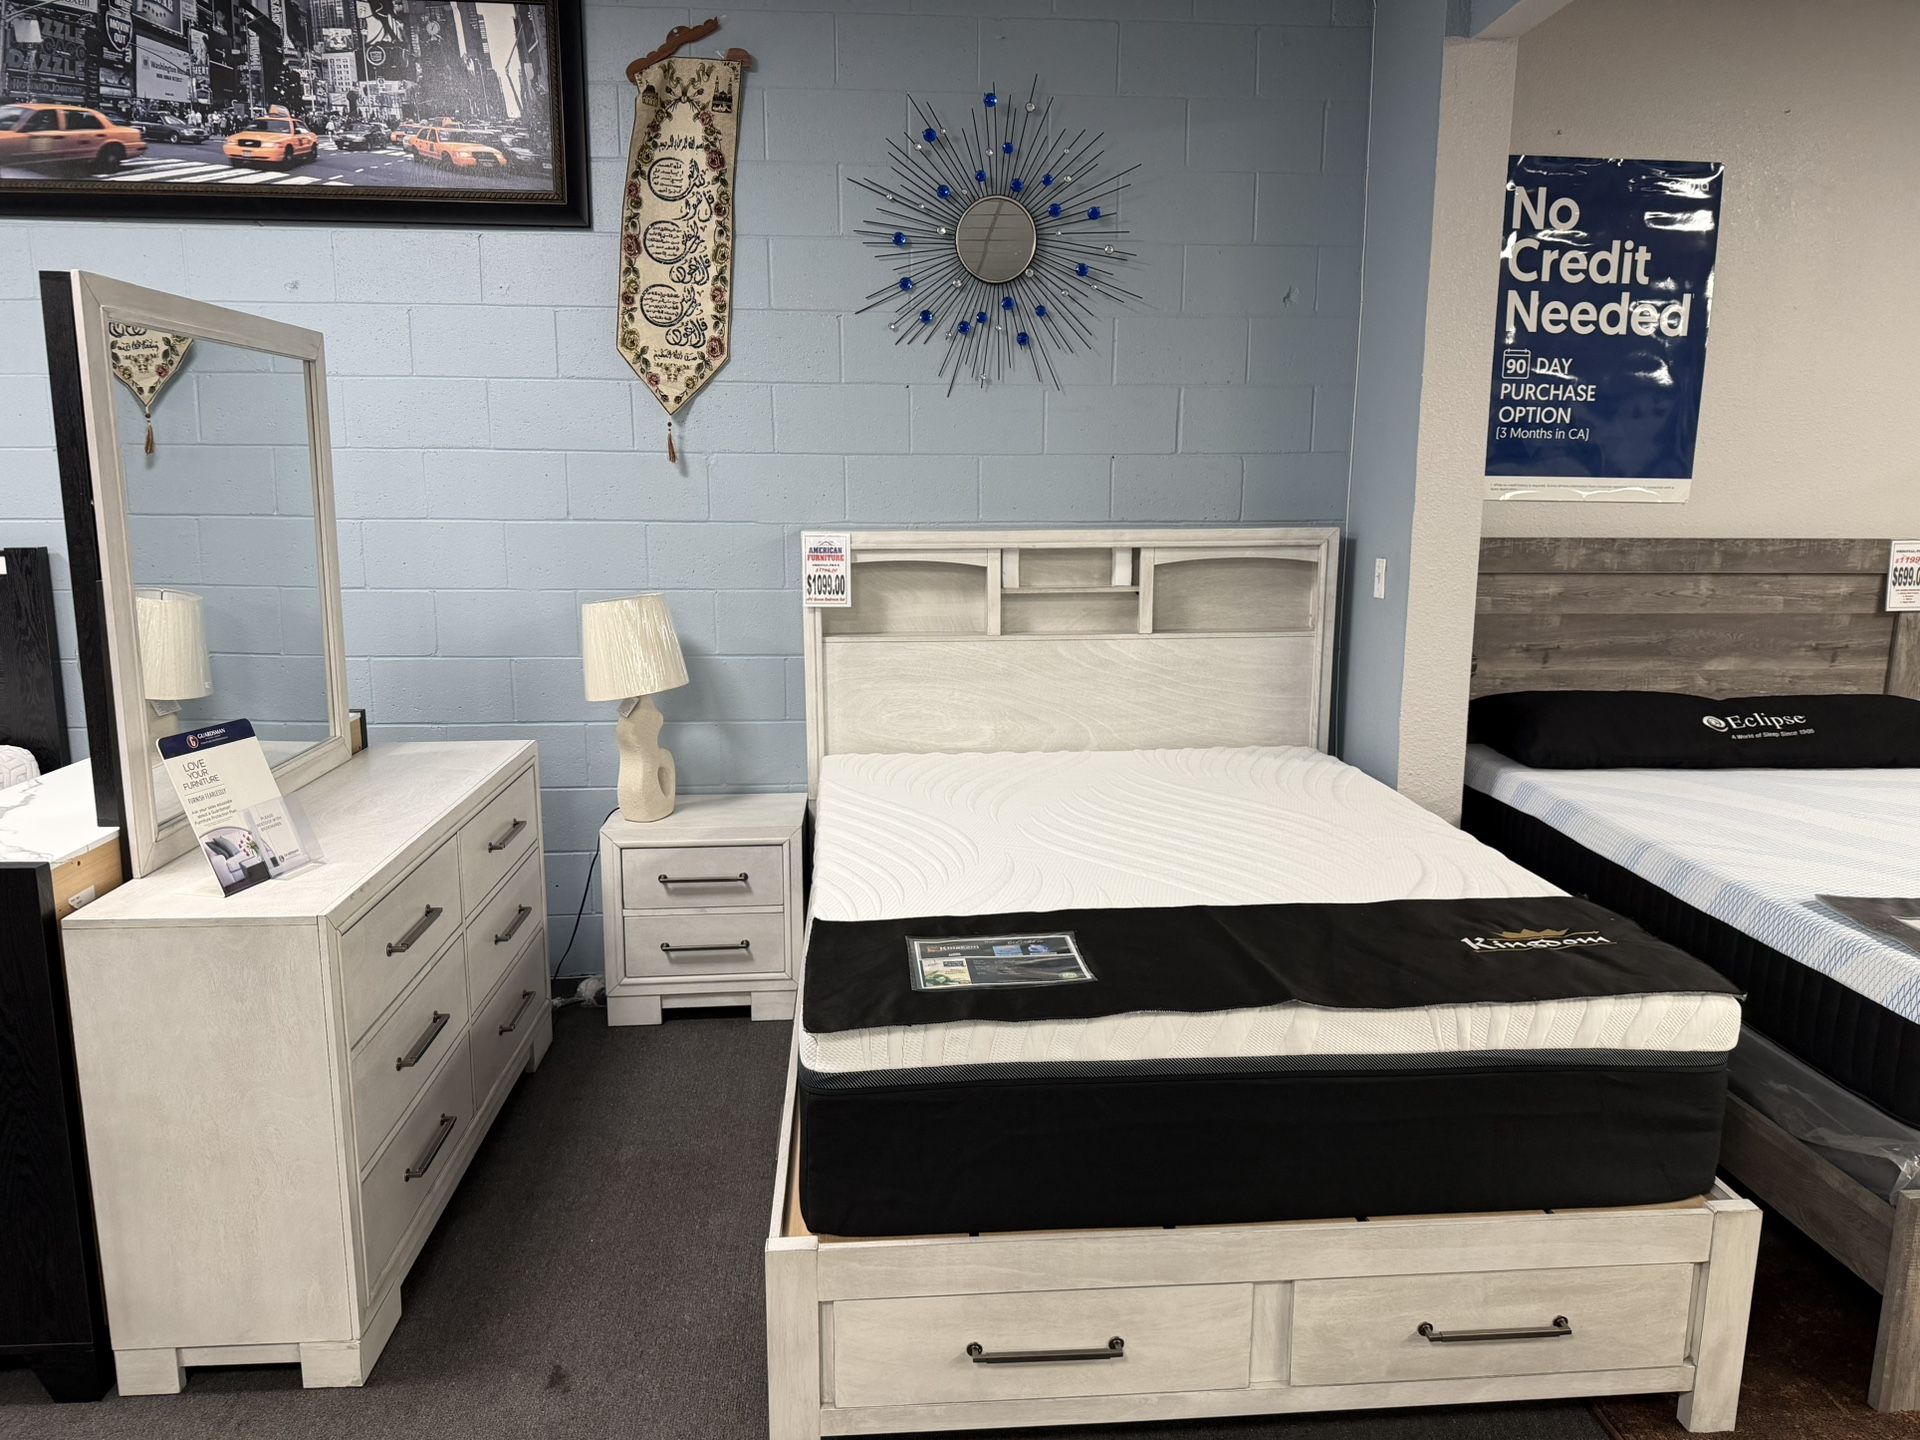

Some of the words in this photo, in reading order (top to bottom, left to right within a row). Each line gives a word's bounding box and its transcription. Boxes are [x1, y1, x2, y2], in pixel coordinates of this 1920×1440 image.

[1512, 186, 1581, 231] No
[1508, 238, 1652, 285] Credit
[1505, 289, 1692, 337] Needed
[1505, 358, 1527, 374] 90
[1536, 357, 1573, 375] DAY
[1500, 383, 1597, 402] PURCHASE
[1498, 406, 1572, 424] OPTION
[1510, 427, 1553, 440] Months
[1555, 428, 1566, 440] in
[807, 574, 845, 595] $1099.00
[1725, 712, 1807, 730] Eclipse
[182, 759, 206, 772] LOVE
[186, 768, 209, 780] YOUR
[183, 774, 220, 790] FURNITURE
